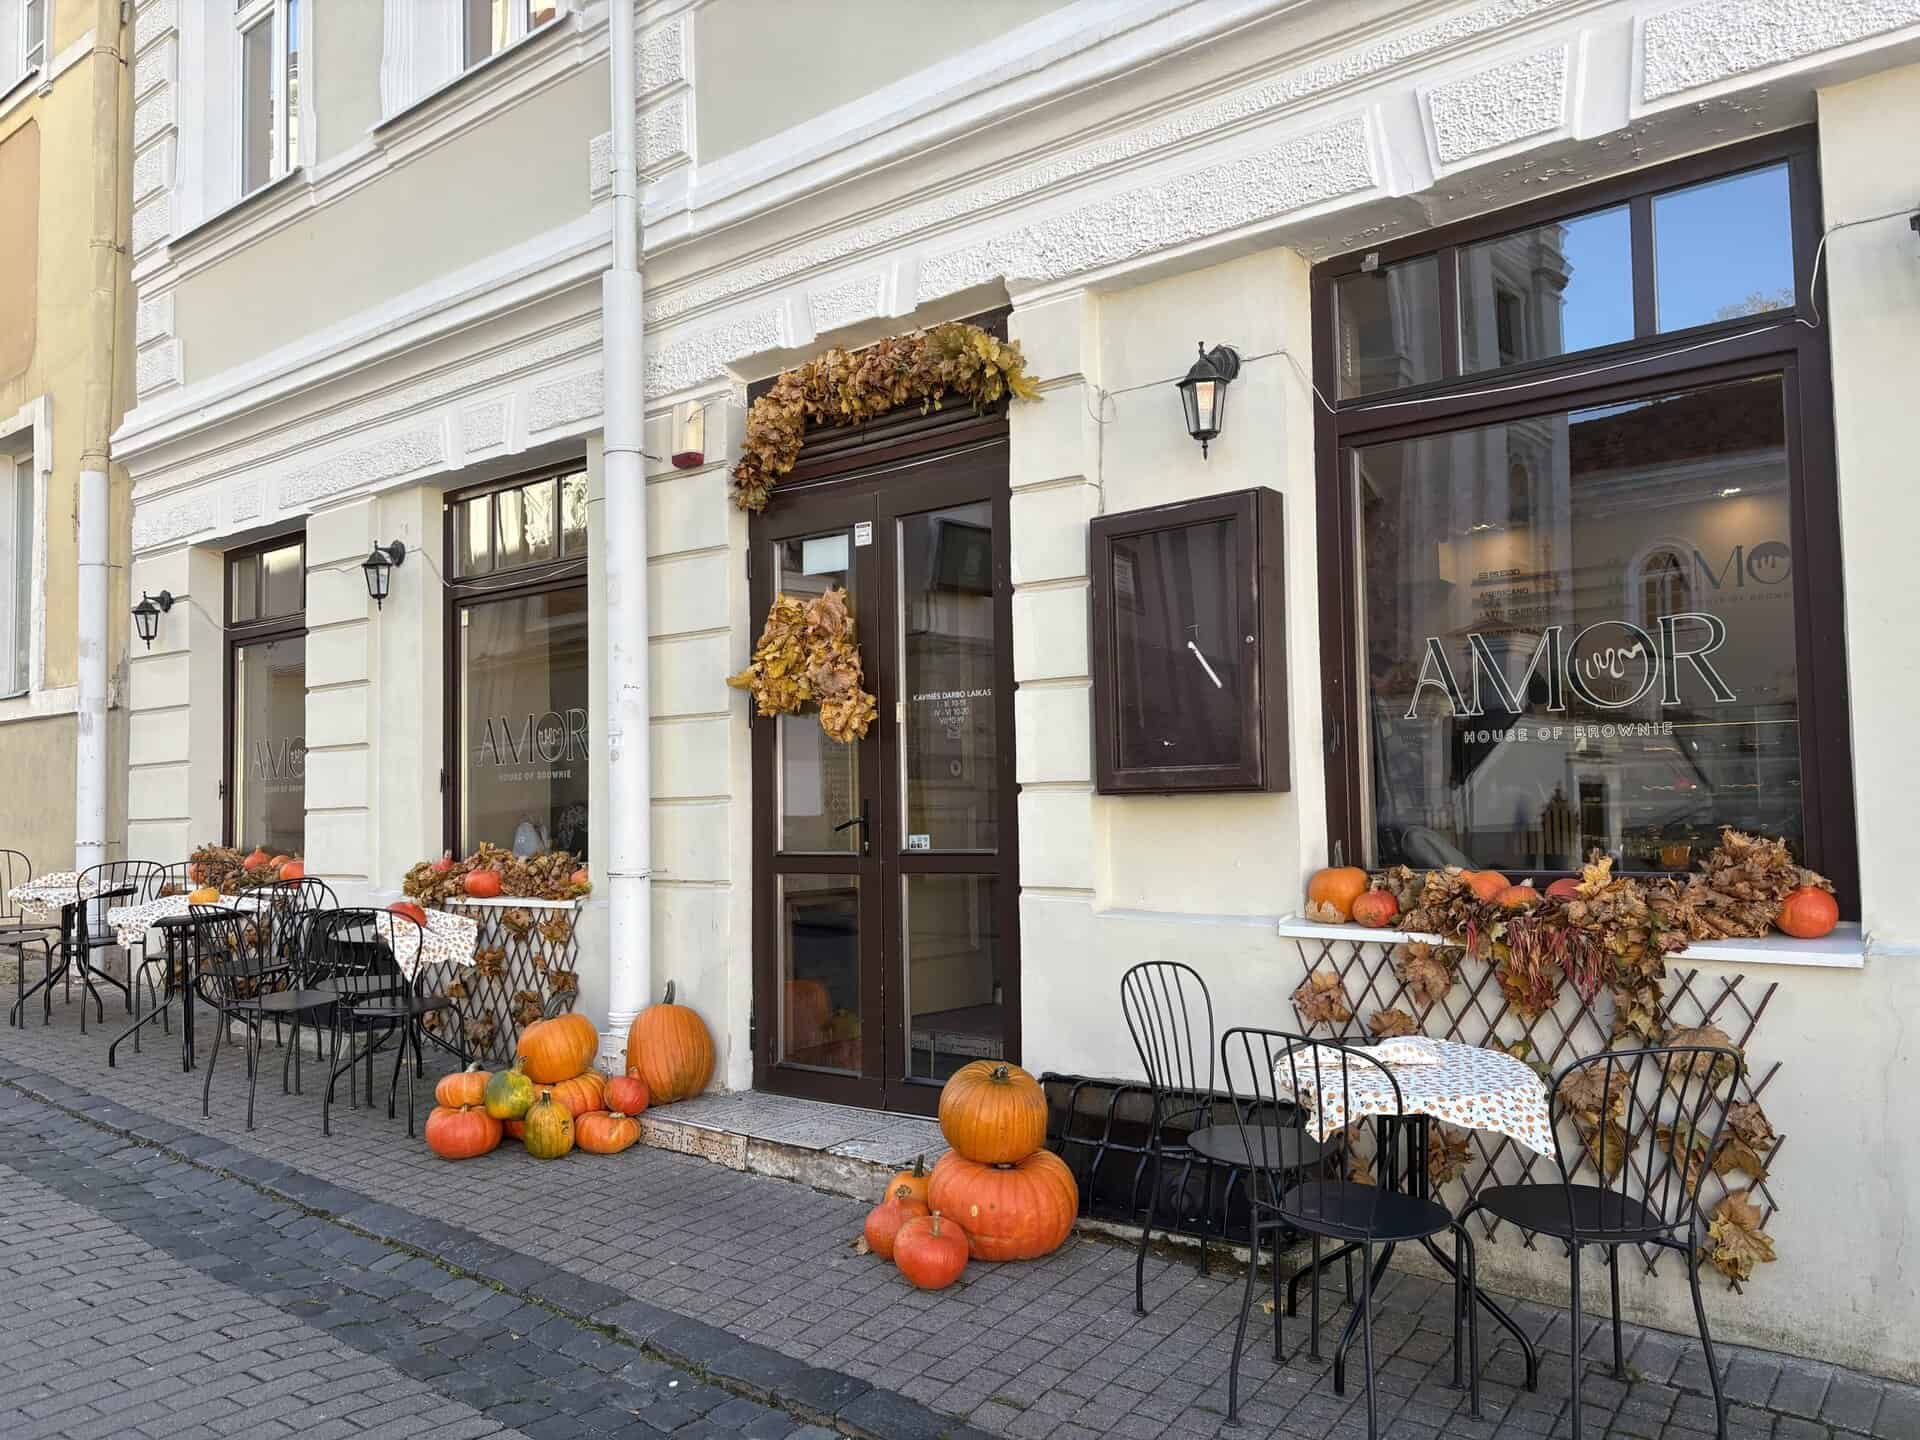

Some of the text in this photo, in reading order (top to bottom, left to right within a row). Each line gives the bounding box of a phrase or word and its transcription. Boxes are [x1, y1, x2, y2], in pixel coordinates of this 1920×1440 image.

[1660, 541, 1792, 591] AMO
[1404, 612, 1737, 720] AMOR
[967, 688, 992, 698] LAIKAS
[477, 708, 588, 767] AMOR
[1464, 721, 1674, 744] HOUSE OF BROWNIE
[252, 736, 305, 781] AMO
